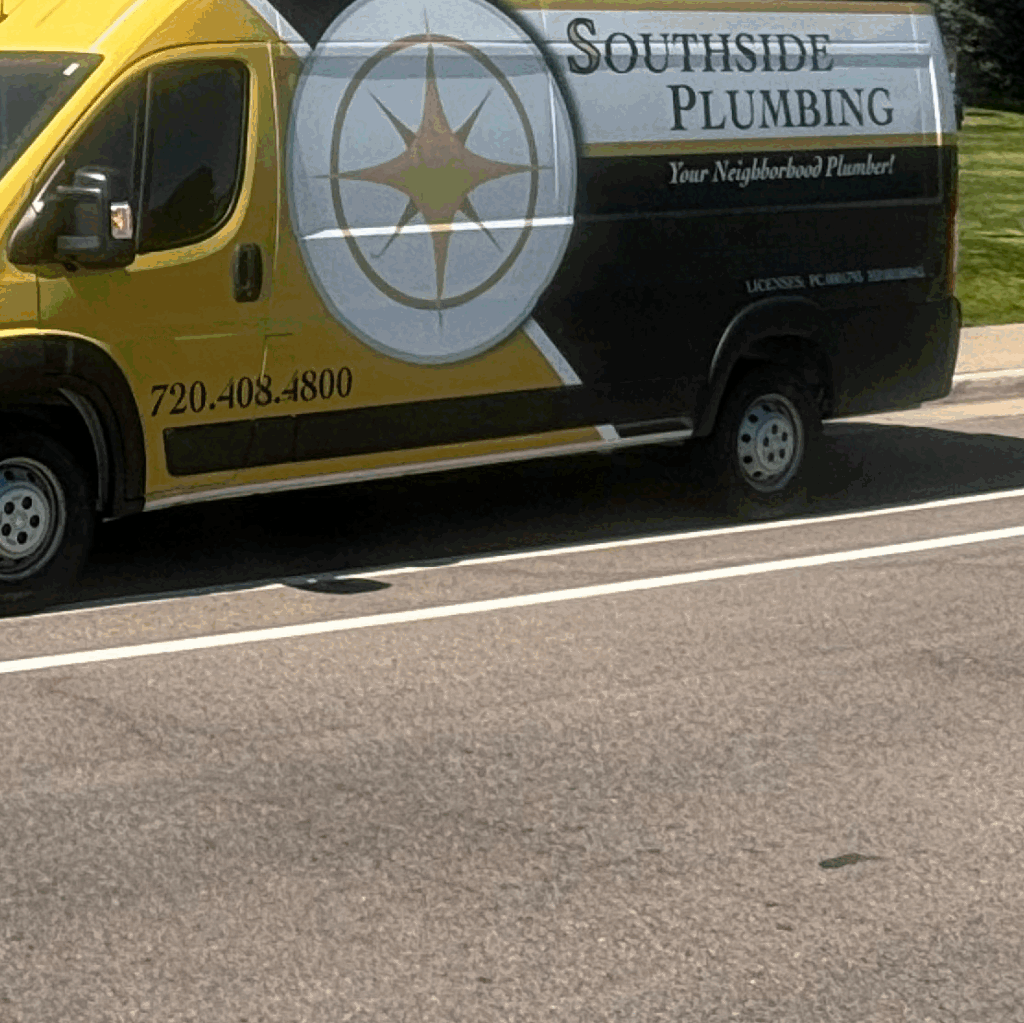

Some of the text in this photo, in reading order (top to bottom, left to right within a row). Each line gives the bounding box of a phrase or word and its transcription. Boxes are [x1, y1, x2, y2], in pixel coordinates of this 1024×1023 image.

[566, 17, 835, 75] SOUTHSIDE
[666, 83, 895, 131] PLUMBING
[668, 153, 896, 188] Your Neighborhood Plumber!
[150, 366, 354, 418] 720.408.4800
